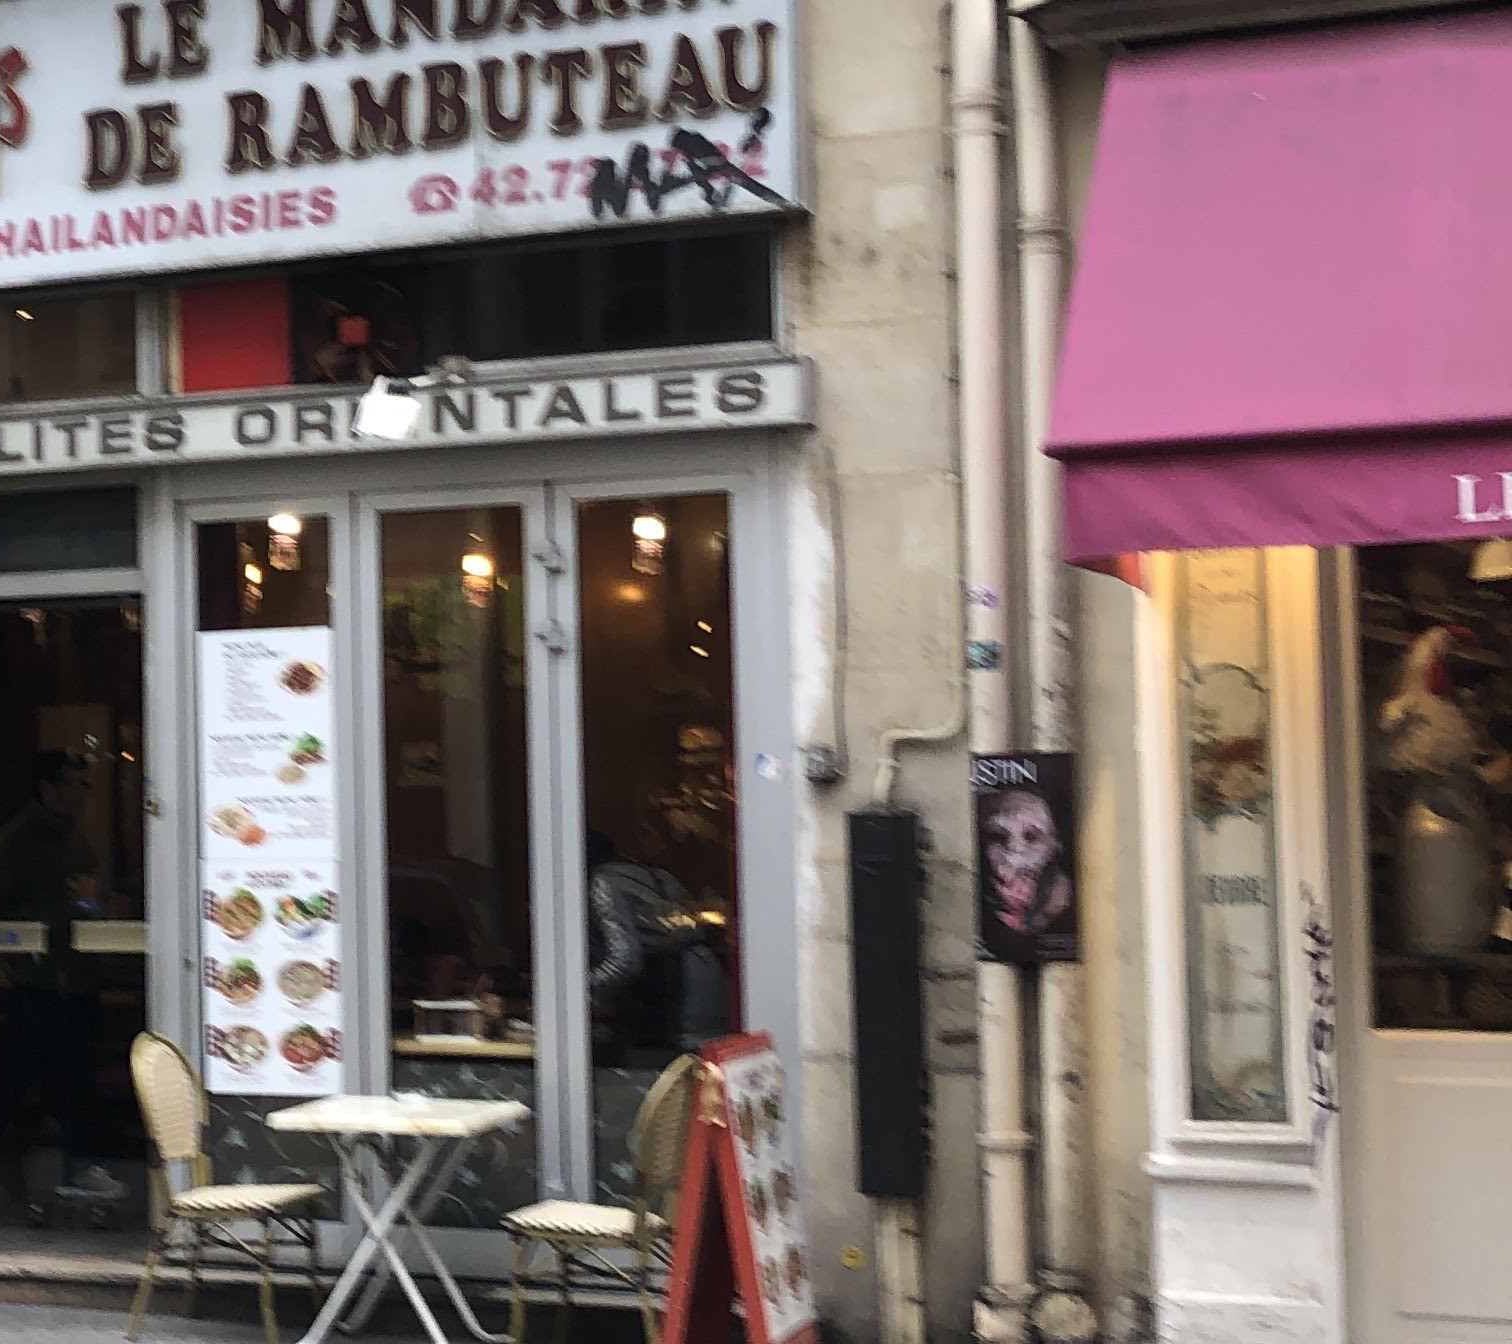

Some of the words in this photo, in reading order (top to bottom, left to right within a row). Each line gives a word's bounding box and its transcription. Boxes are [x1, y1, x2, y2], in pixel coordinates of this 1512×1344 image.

[82, 101, 181, 190] DE
[225, 20, 779, 172] RAMBUTEAU
[234, 369, 766, 446] ORNTALES
